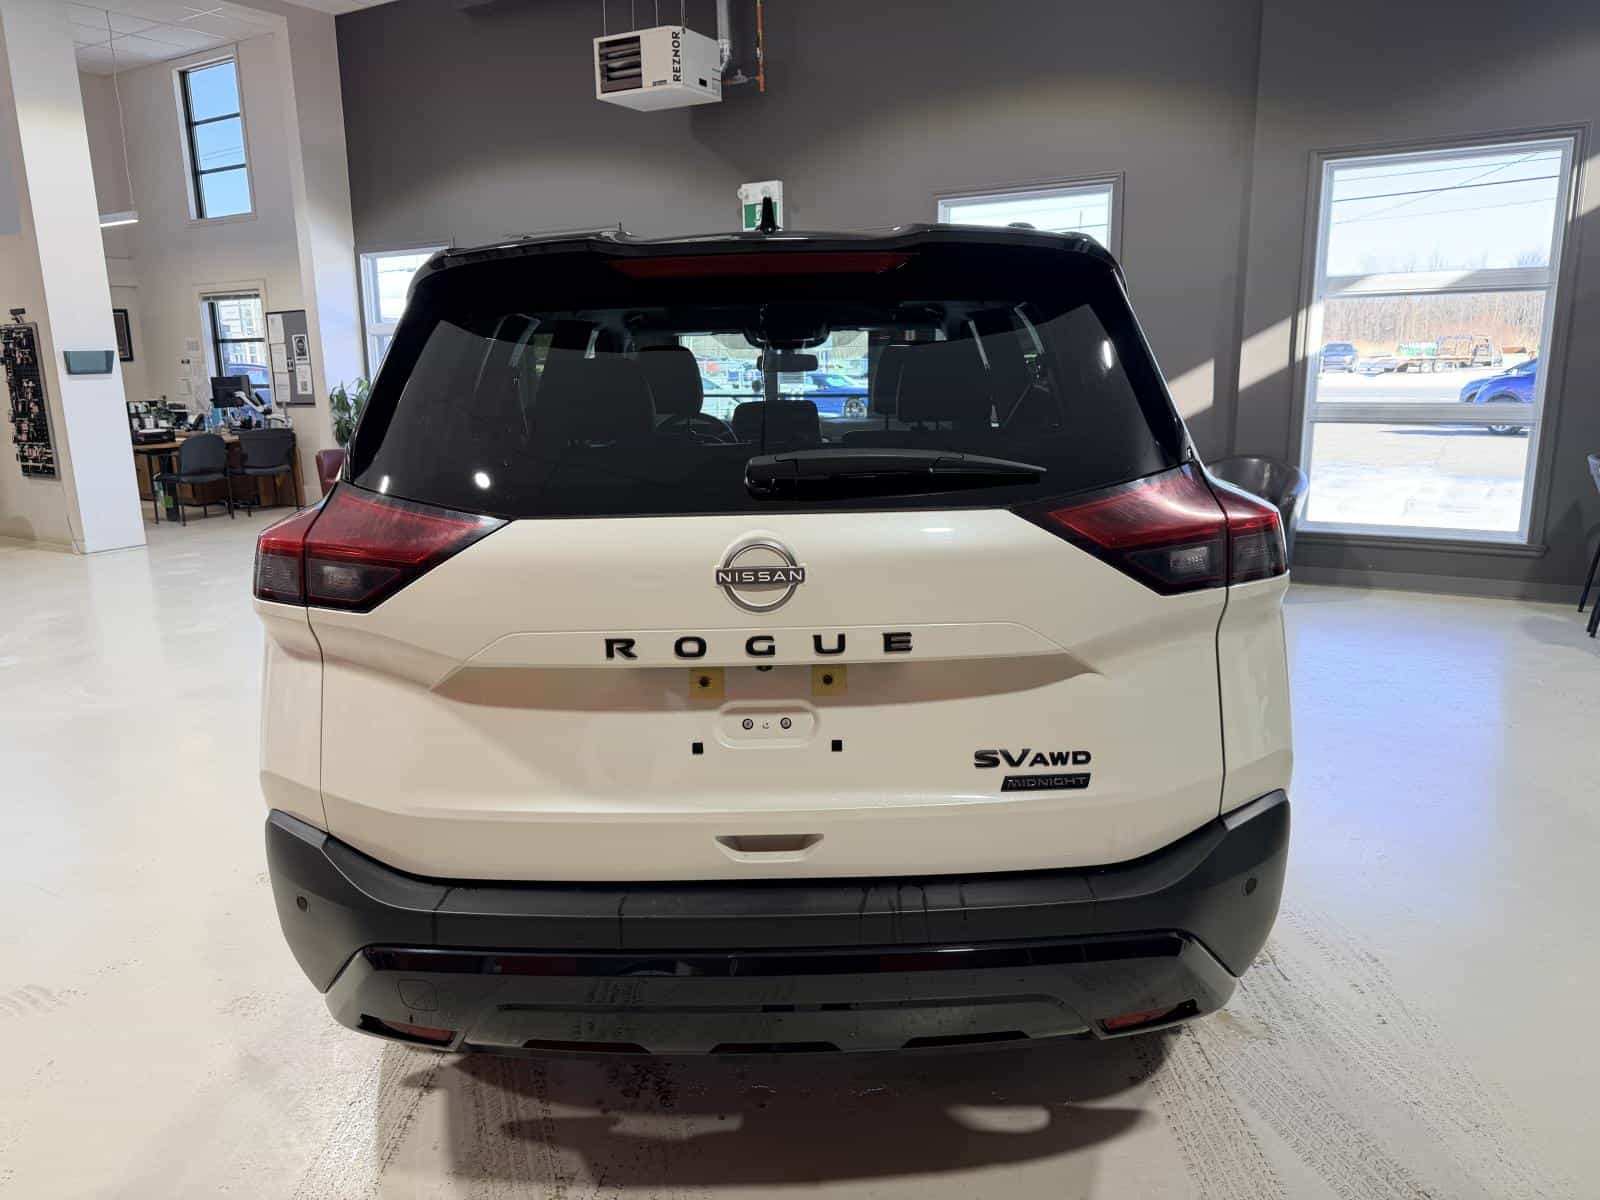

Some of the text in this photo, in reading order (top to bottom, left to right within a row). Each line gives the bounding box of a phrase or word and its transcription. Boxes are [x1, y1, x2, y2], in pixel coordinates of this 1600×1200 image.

[671, 31, 682, 82] REZNOR
[718, 569, 804, 584] NISSAN
[604, 631, 914, 660] ROGUE
[1006, 776, 1087, 788] MIDNIGHT
